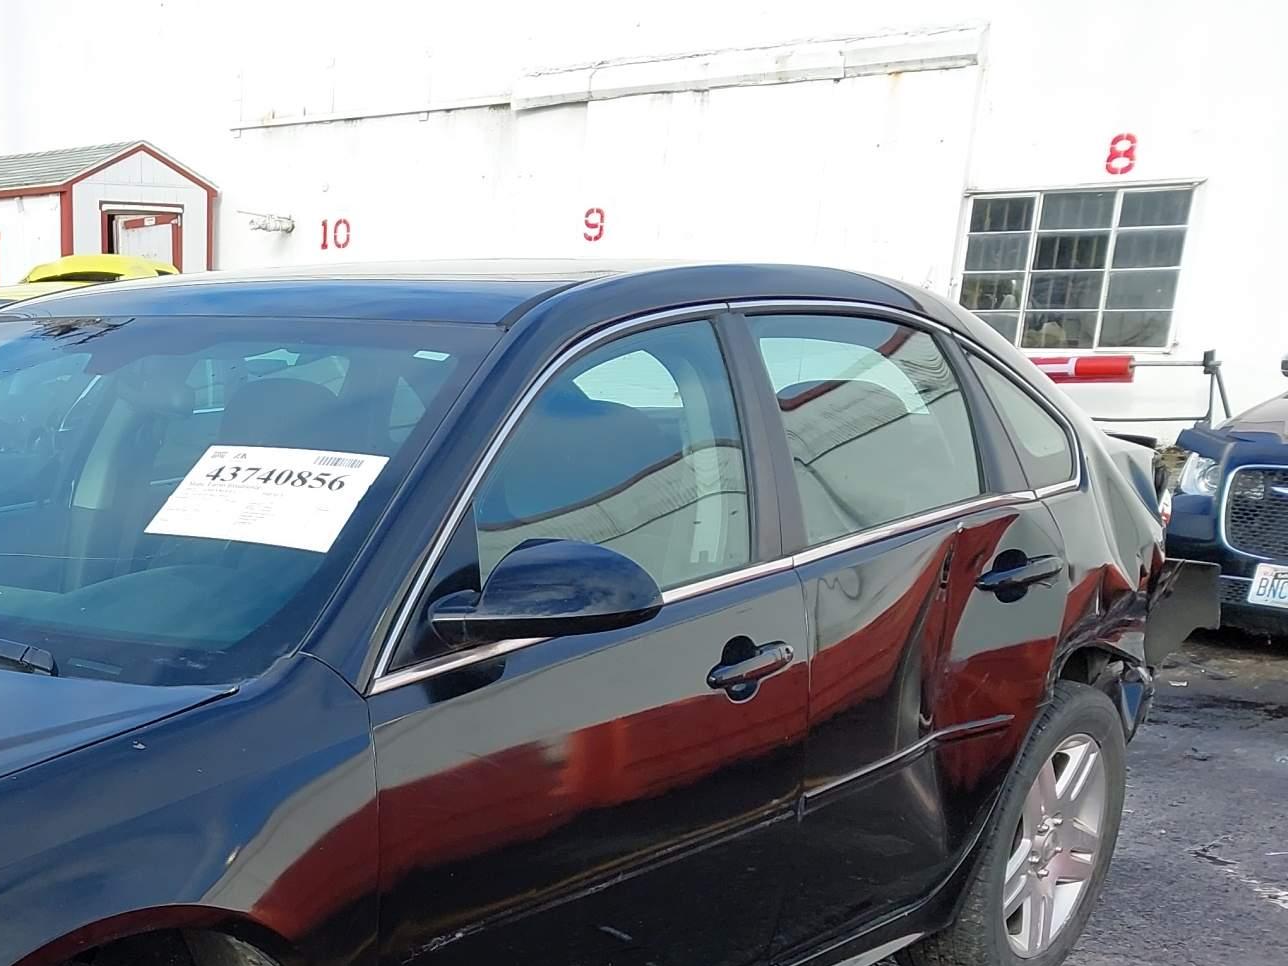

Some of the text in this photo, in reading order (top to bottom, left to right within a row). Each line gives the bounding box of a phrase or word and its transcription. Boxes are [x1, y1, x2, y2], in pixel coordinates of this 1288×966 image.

[1105, 133, 1137, 175] 8
[321, 218, 351, 250] 10
[583, 207, 605, 242] 9
[205, 465, 352, 492] 43740856
